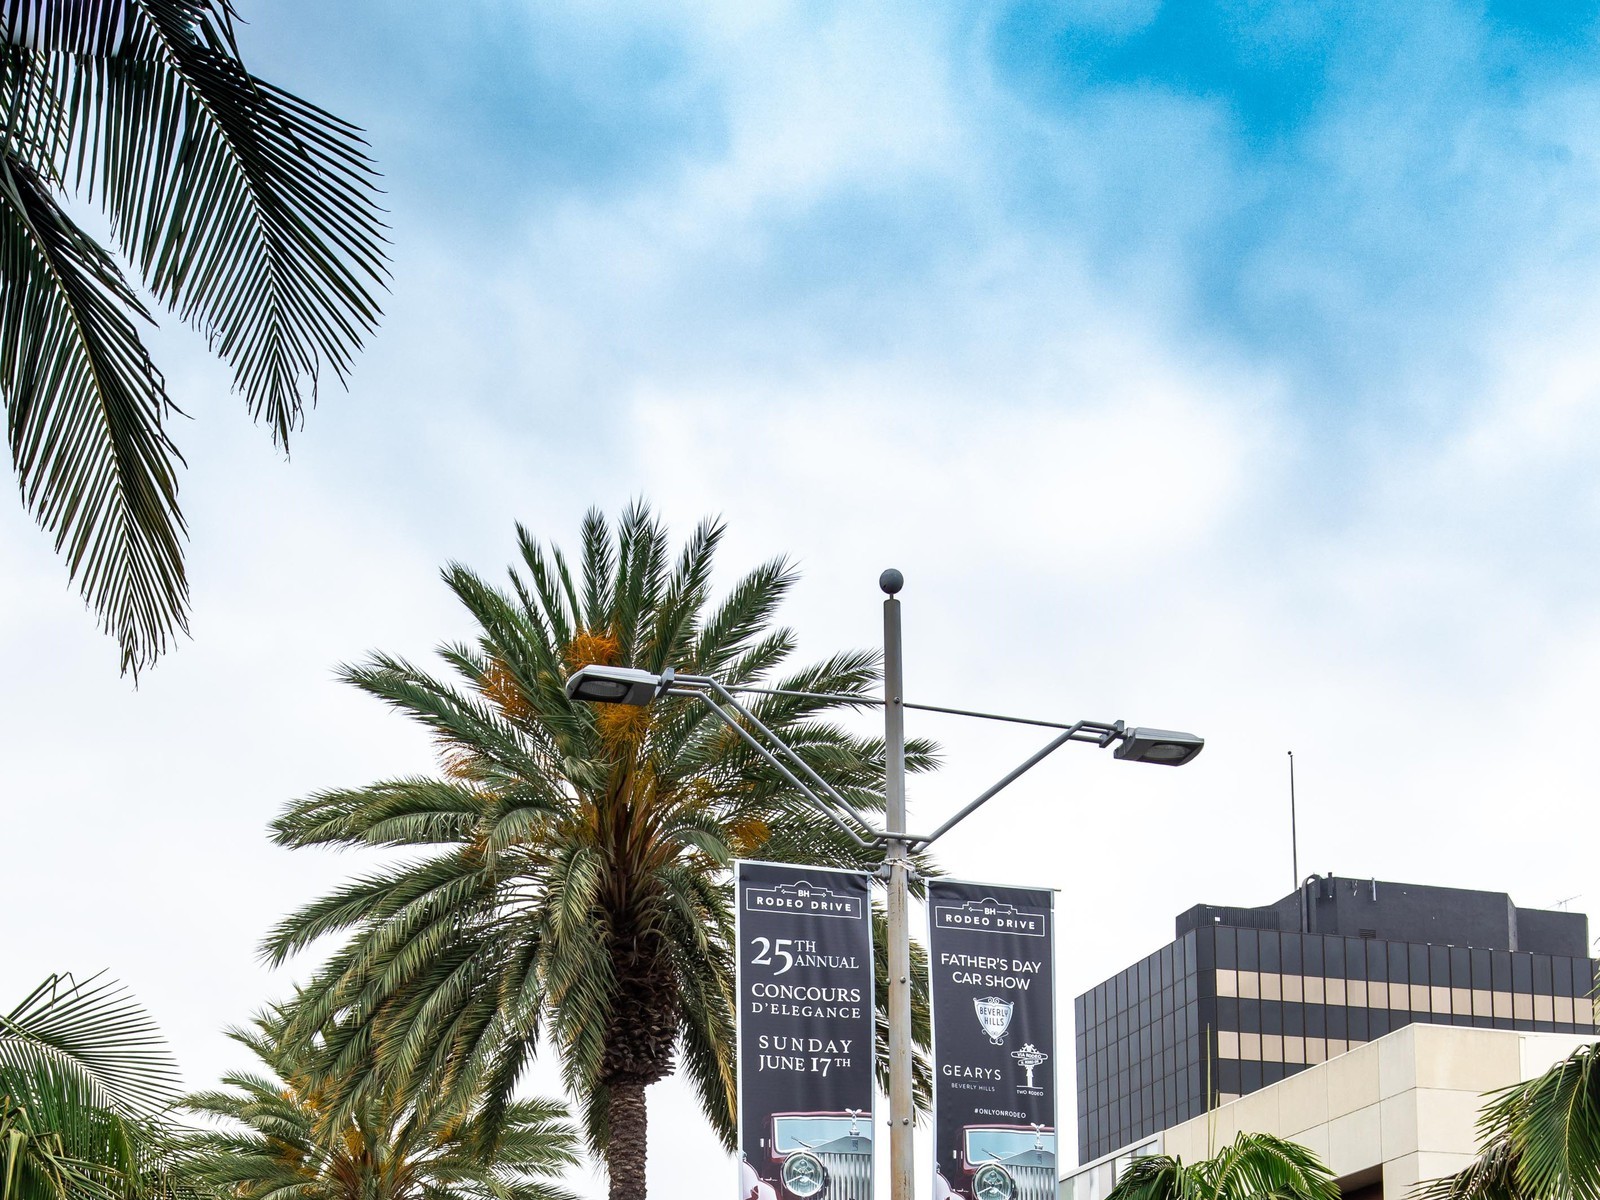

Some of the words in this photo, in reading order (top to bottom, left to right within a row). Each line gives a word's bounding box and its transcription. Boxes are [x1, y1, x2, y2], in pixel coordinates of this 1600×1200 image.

[798, 890, 810, 898] BH
[757, 897, 803, 908] RODEO
[811, 901, 851, 912] DRIVE
[984, 907, 996, 915] BH
[945, 914, 990, 926] RODEO
[997, 918, 1035, 930] DRIVE
[794, 954, 860, 969] ANNUAL
[941, 953, 1008, 971] FATHER'S
[1012, 960, 1042, 974] DAY
[952, 971, 982, 985] CAR
[985, 975, 1031, 991] SHOW
[751, 982, 861, 1003] CONCOURS
[751, 1002, 861, 1019] D'ELEGANCE
[981, 1006, 1009, 1018] BEVERLY
[984, 1018, 1005, 1027] HILLS
[759, 1035, 852, 1053] SUNDAY
[758, 1055, 806, 1072] JUNE
[942, 1064, 1002, 1081] GEARYS
[951, 1083, 977, 1091] BEVERLY
[974, 1108, 1027, 1119] #ONLYONRODEO
